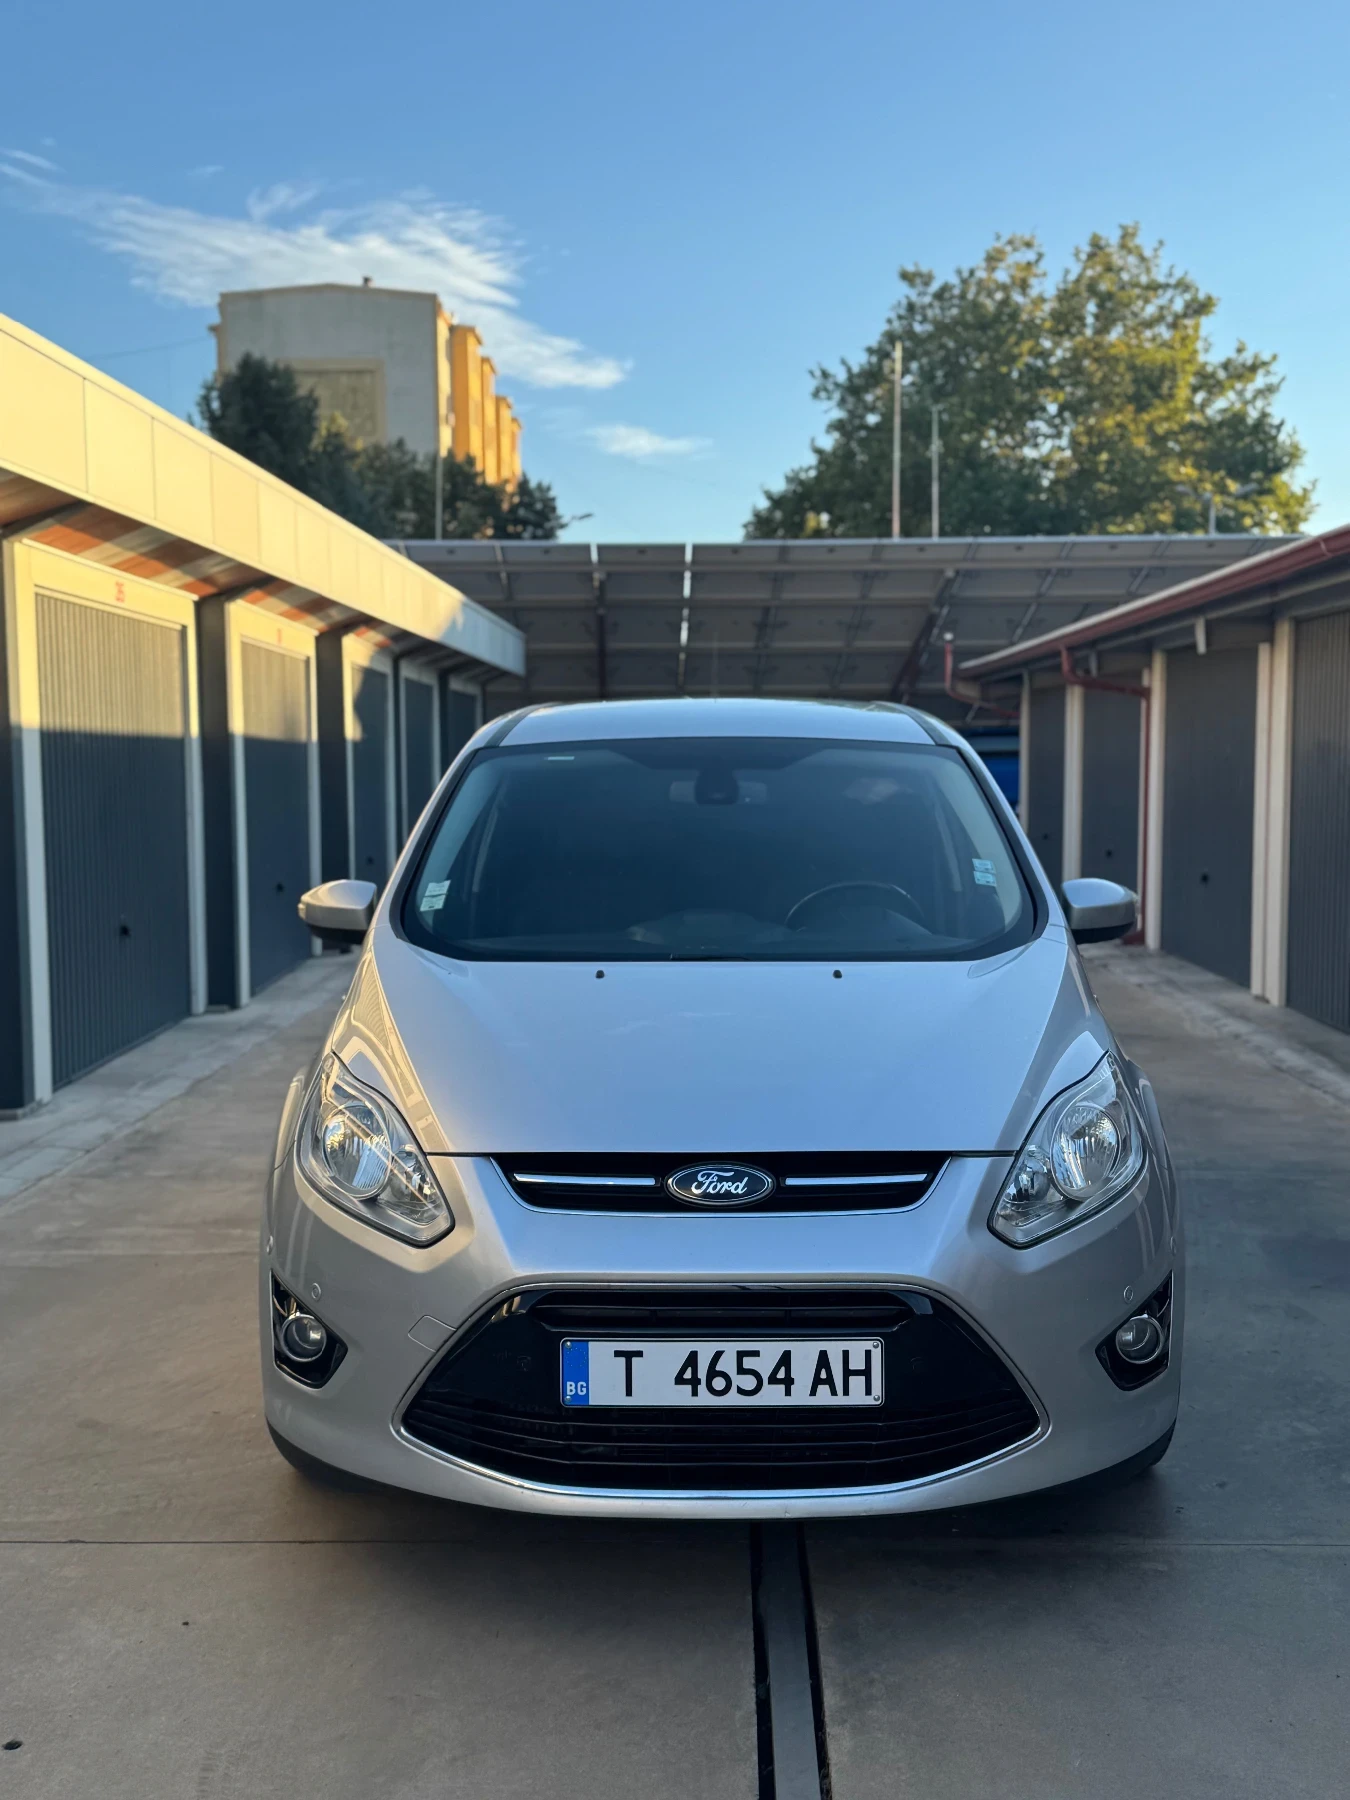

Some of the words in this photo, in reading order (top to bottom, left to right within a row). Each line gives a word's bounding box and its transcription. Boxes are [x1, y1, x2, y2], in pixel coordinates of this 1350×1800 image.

[691, 1171, 749, 1194] Ford
[614, 1350, 643, 1397] T
[674, 1350, 795, 1397] 4654
[809, 1350, 873, 1397] AH
[566, 1381, 587, 1396] BG
